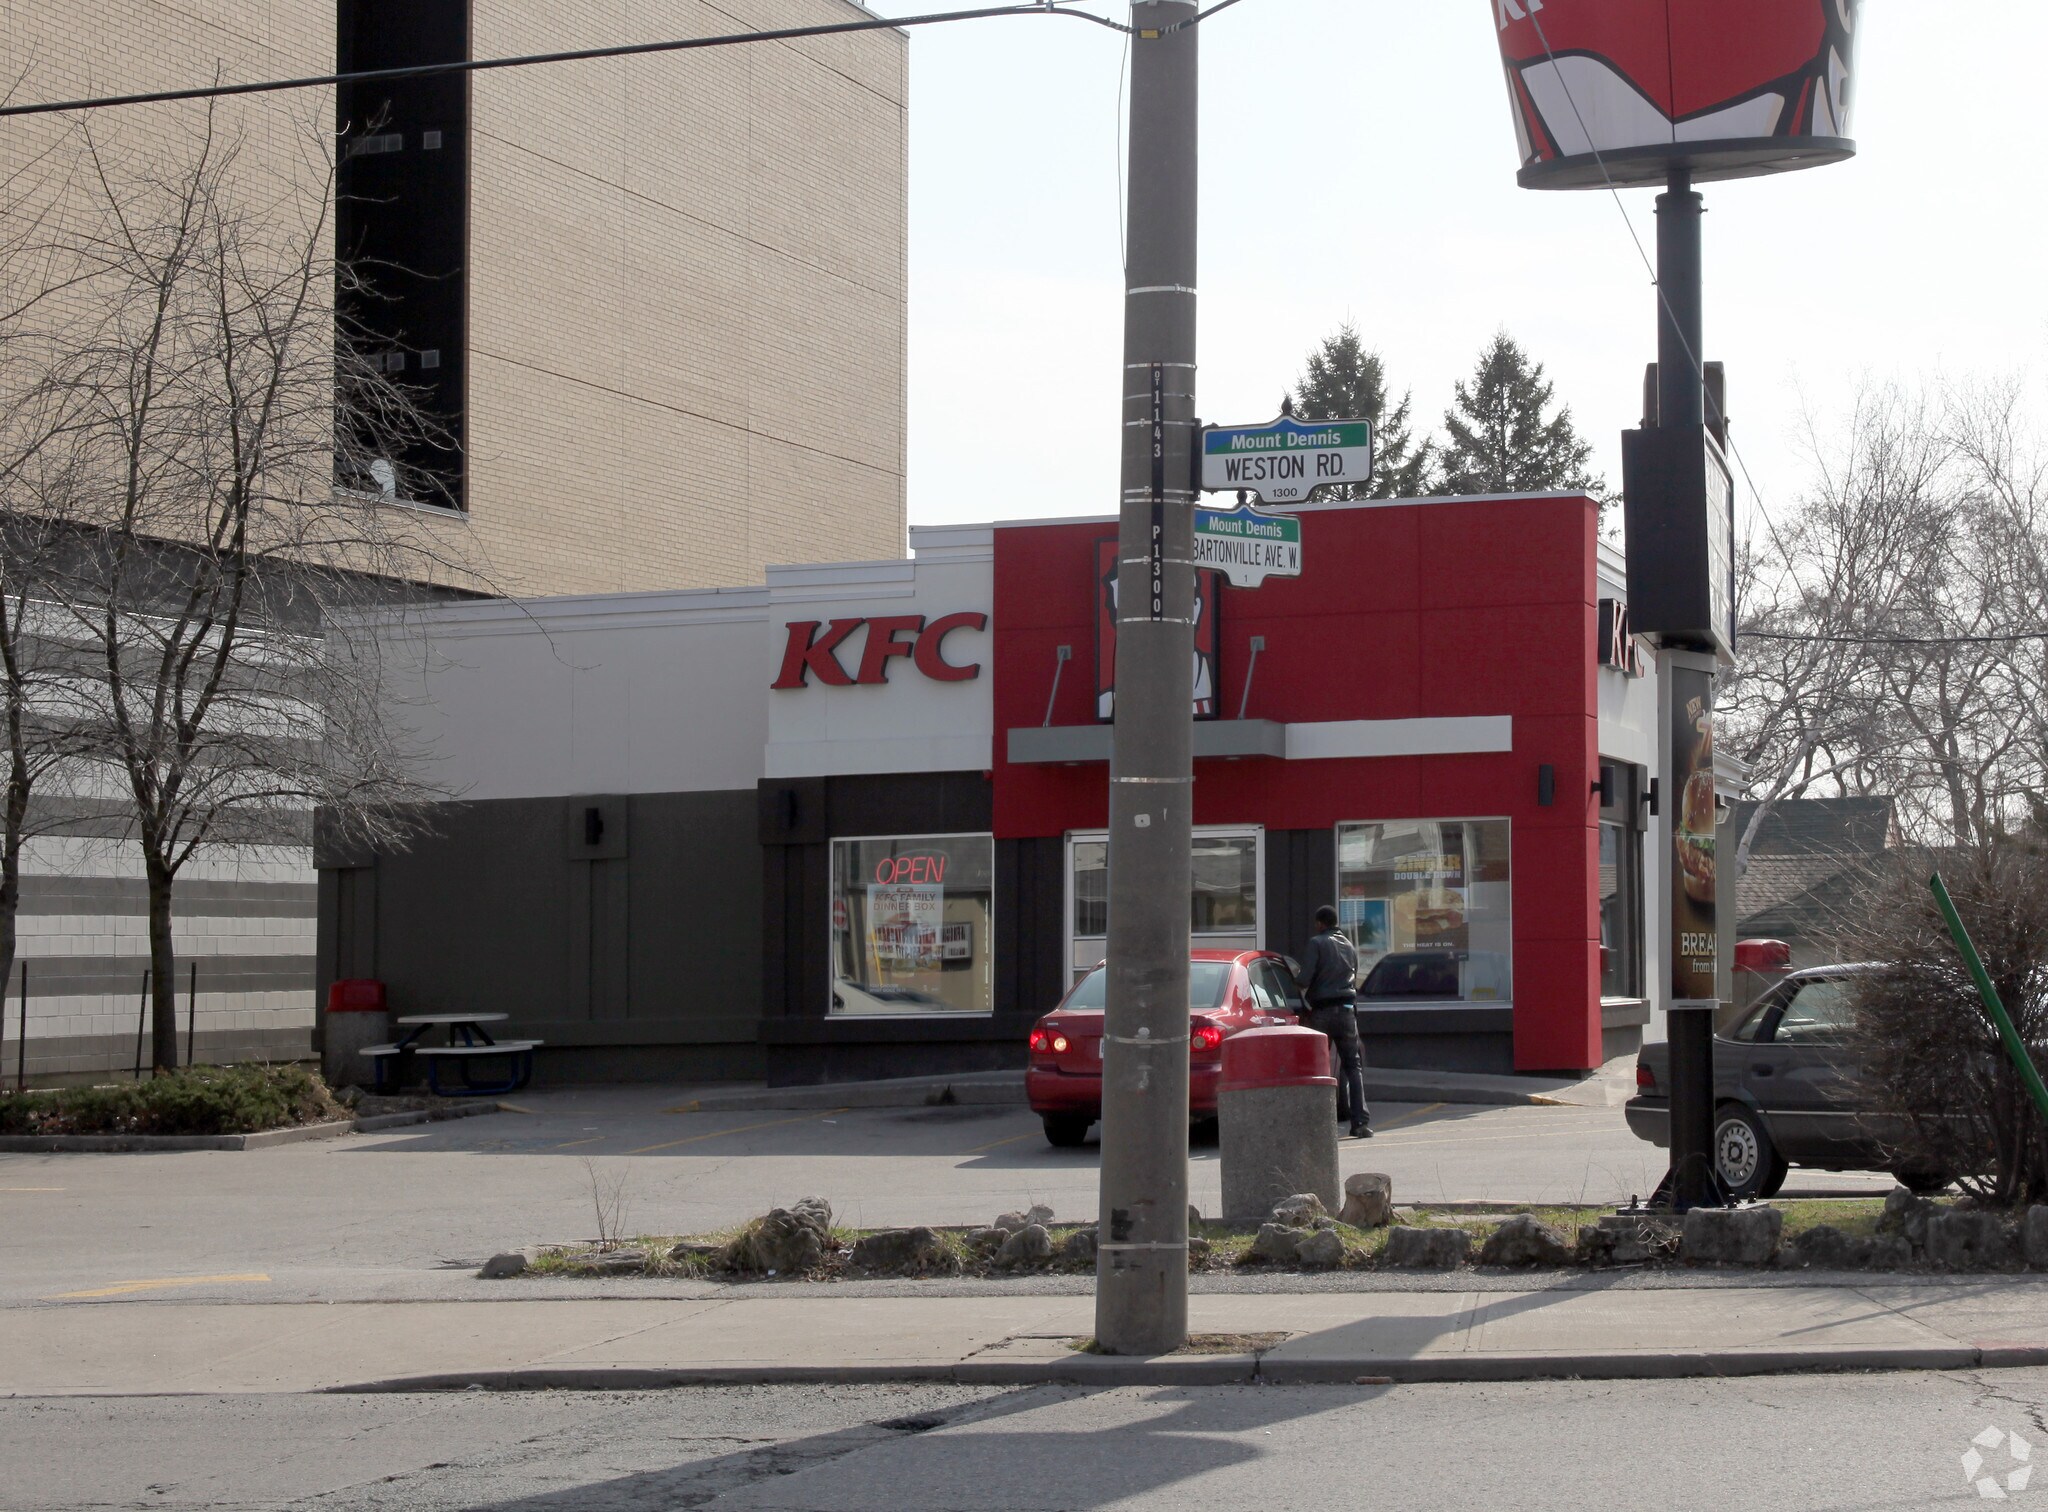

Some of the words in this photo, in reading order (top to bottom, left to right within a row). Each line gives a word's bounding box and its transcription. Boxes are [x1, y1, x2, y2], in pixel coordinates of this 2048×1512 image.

[1231, 433, 1282, 450] Mount
[1286, 428, 1342, 447] Dennis
[1225, 454, 1305, 482] WESTON
[1316, 453, 1346, 477] RD.
[1272, 487, 1298, 498] 1300
[1208, 515, 1243, 534] Mount
[1246, 519, 1283, 538] Dennis
[1194, 537, 1262, 566] BARTONVILLE
[1264, 544, 1286, 568] AVE.
[1288, 546, 1299, 570] W.
[1152, 525, 1161, 612] P1300
[770, 611, 988, 690] KFC
[1686, 696, 1702, 719] NEW
[876, 856, 945, 885] OPEN
[1394, 871, 1431, 881] DOUBLE
[1433, 870, 1461, 880] DOWN
[874, 893, 898, 902] KFC
[899, 892, 937, 902] FAMILY
[914, 902, 936, 911] BOX
[1681, 932, 1718, 956] BREA
[1692, 958, 1710, 973] from
